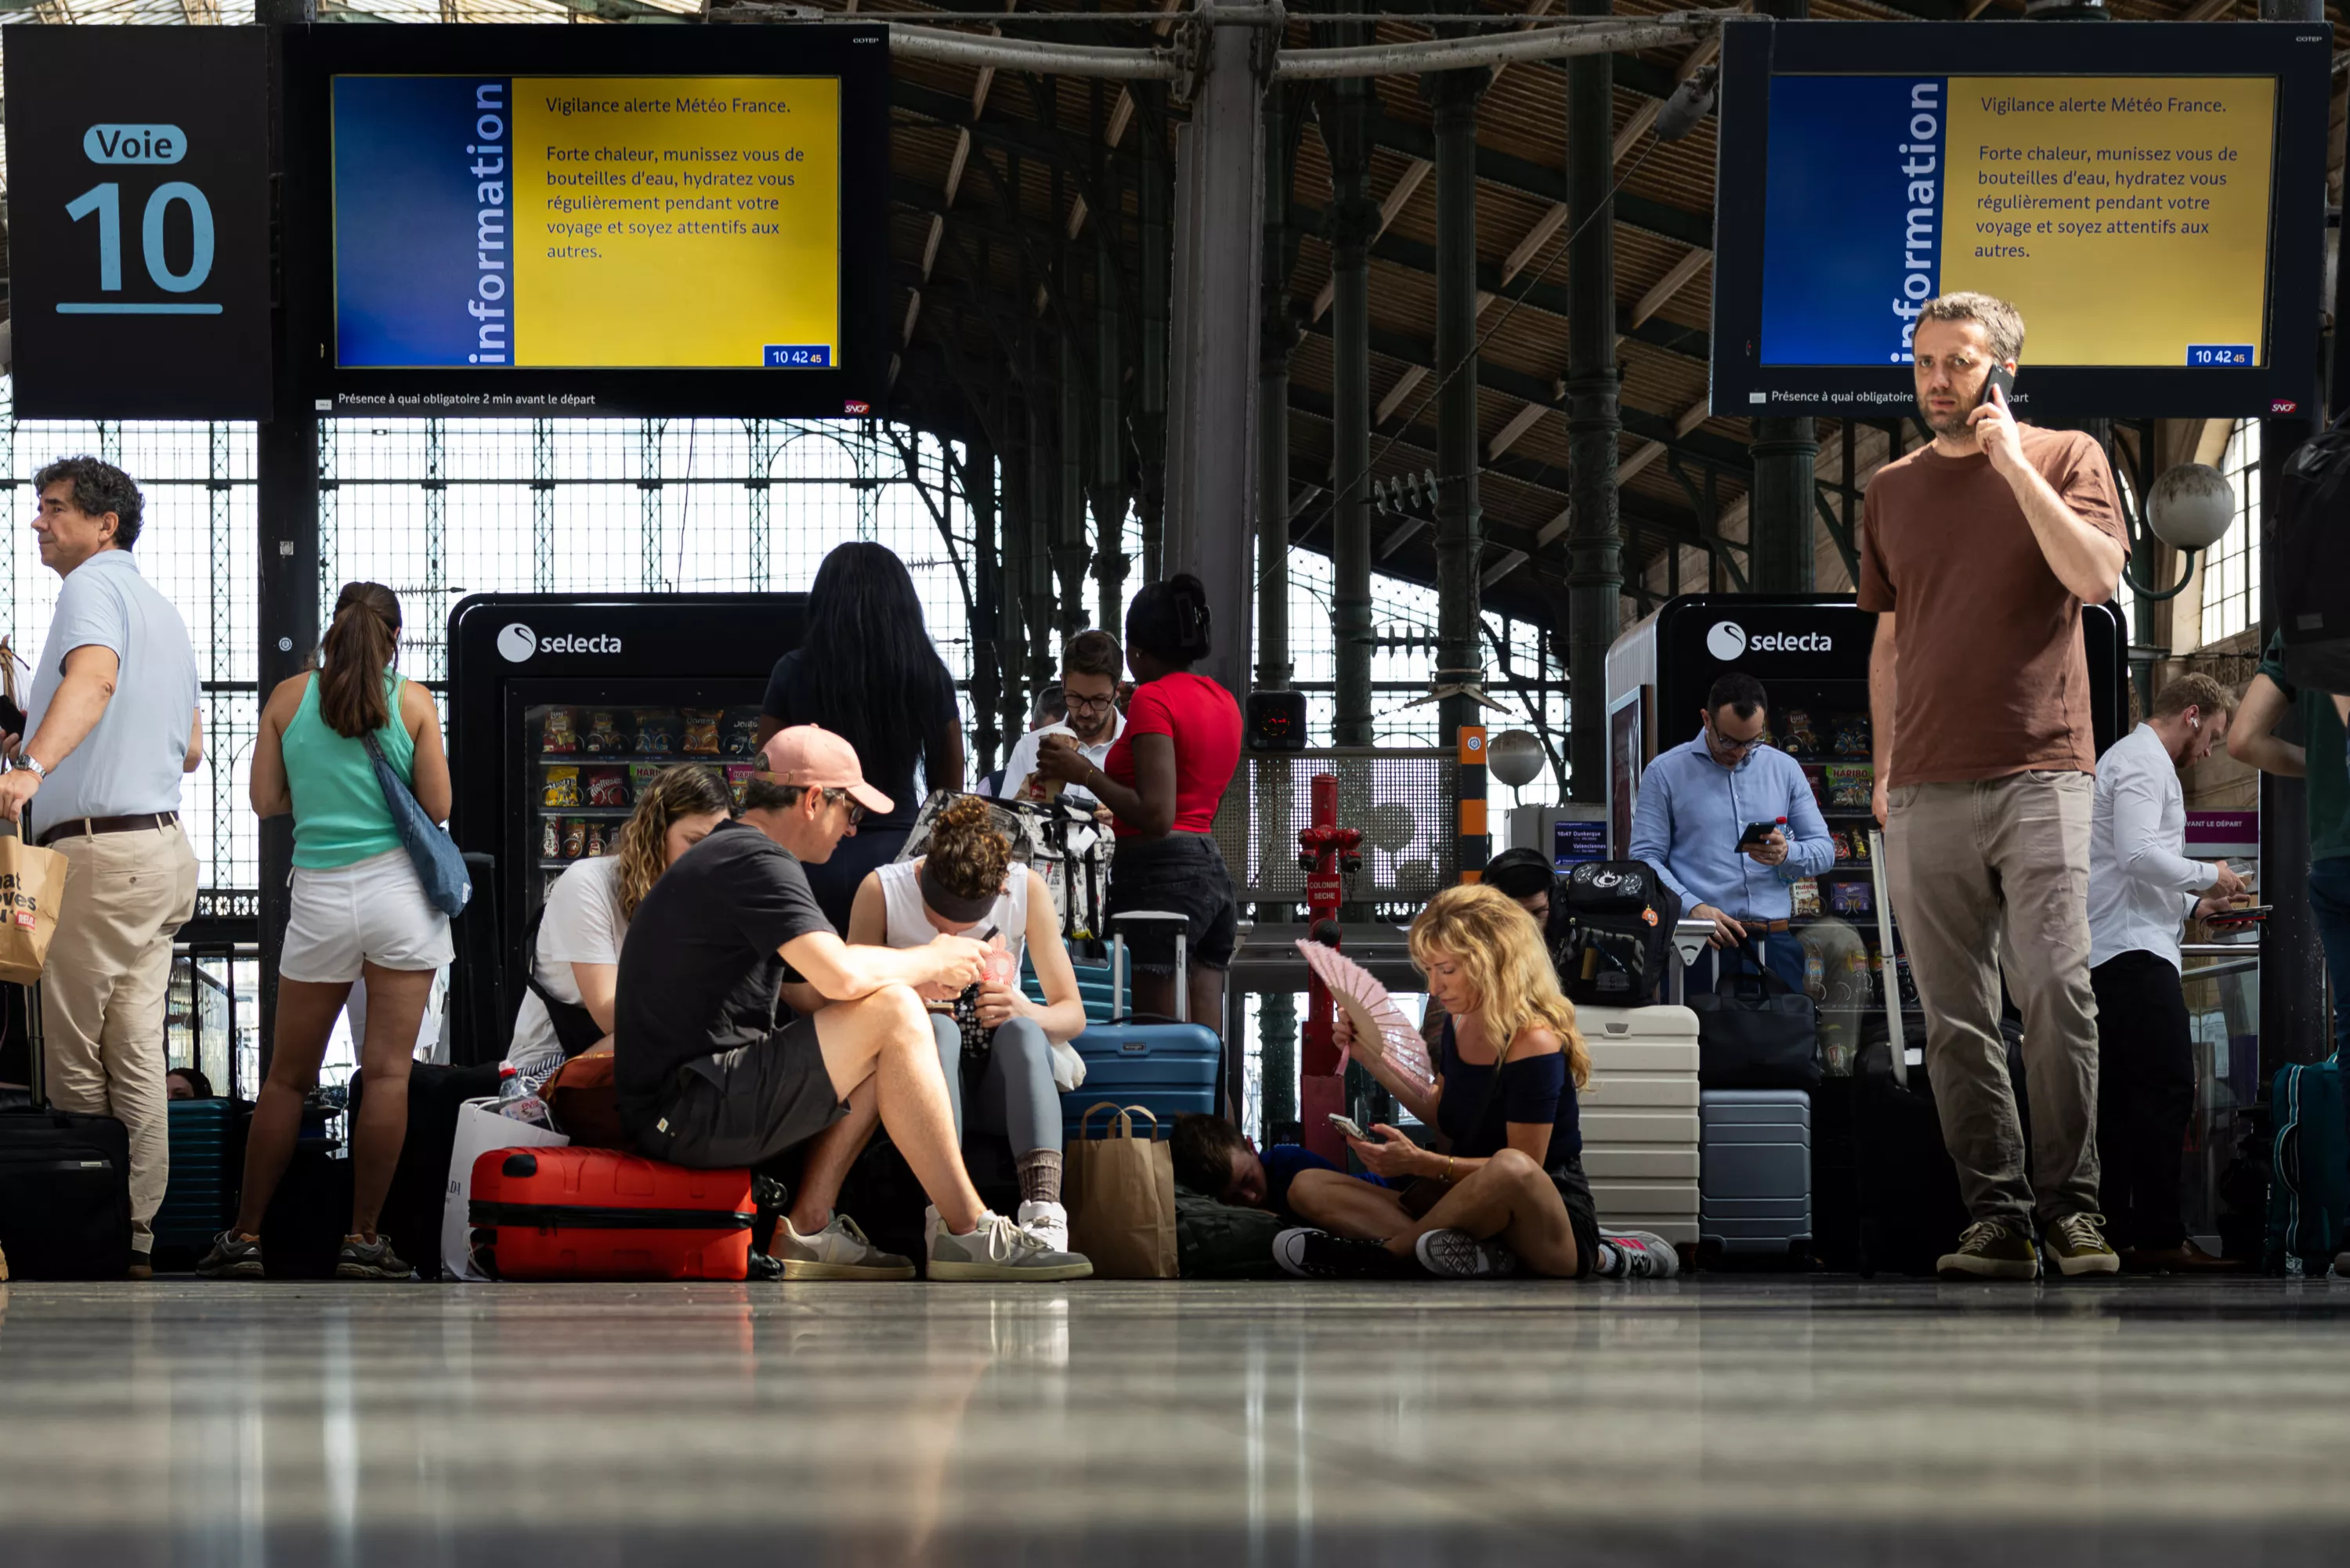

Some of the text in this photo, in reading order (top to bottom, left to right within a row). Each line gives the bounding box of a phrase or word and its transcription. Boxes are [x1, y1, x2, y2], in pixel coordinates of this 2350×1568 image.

[545, 97, 790, 117] Vigilance alerte Météo France.
[1981, 96, 2226, 116] Vigilance alerte Météo France.
[96, 130, 173, 159] Voie
[547, 146, 804, 164] Forte chaleur, munissez vous de
[1979, 145, 2237, 164] Forte chaleur, munissez vous de
[547, 170, 795, 189] bouteilles d'eau, hydratez vous
[1978, 170, 2227, 190] bouteilles d'eau, hydratez vous
[548, 194, 779, 214] régulièrement pendant votre
[1977, 194, 2210, 214] régulièrement pendant votre
[468, 83, 505, 363] information
[547, 219, 779, 238] voyage et soyez attentifs aux
[1976, 219, 2209, 237] voyage et soyez attentifs aux
[65, 182, 215, 292] 10
[547, 244, 602, 258] autres.
[1974, 244, 2030, 258] autres.
[772, 350, 822, 363] 10 42 45
[2196, 350, 2245, 363] 10 42 45
[338, 393, 595, 407] Présence à quai obligatoire 2 min avant le départ
[1771, 391, 2029, 405] Présence à quai obligatoire part
[2272, 403, 2295, 412] SNCF
[845, 404, 869, 413] SNCF
[540, 634, 622, 653] selecta
[1750, 631, 1832, 652] selecta
[637, 768, 659, 777] HARI
[1833, 769, 1868, 778] HARIBO
[0, 891, 37, 912] ves
